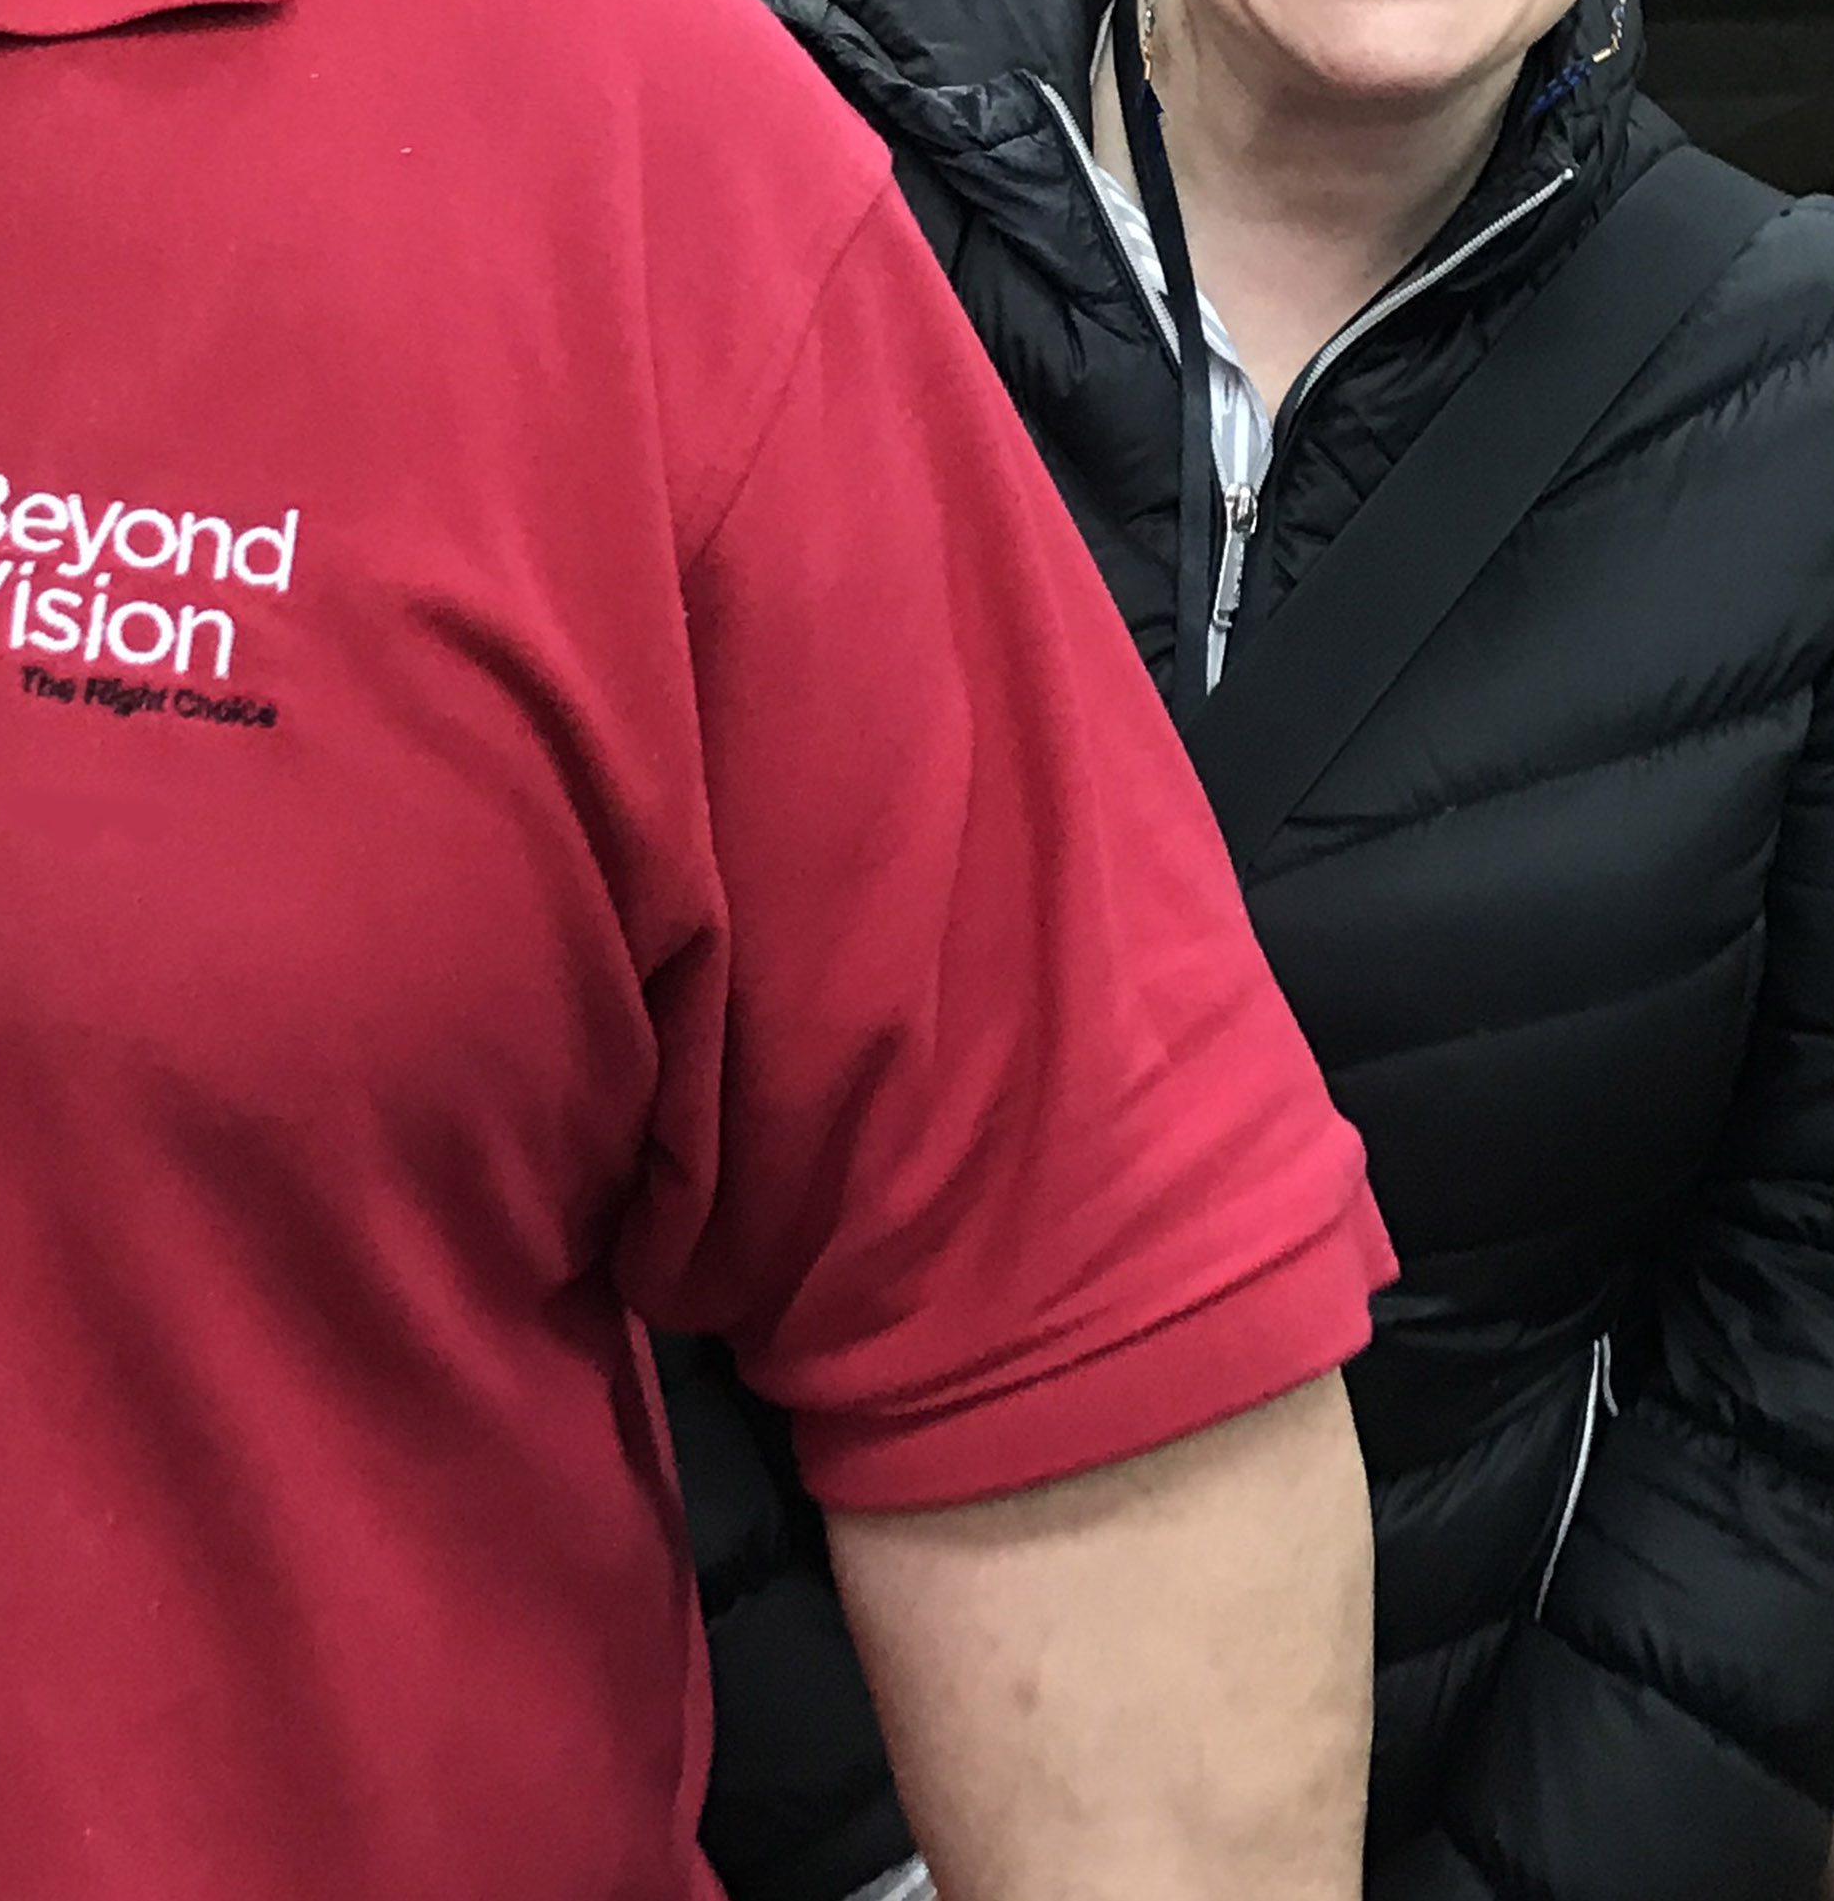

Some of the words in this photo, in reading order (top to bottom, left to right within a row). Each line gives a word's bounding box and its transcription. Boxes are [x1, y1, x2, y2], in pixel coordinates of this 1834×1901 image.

[21, 666, 76, 704] The
[84, 677, 168, 717] Right
[173, 688, 279, 728] Choice
